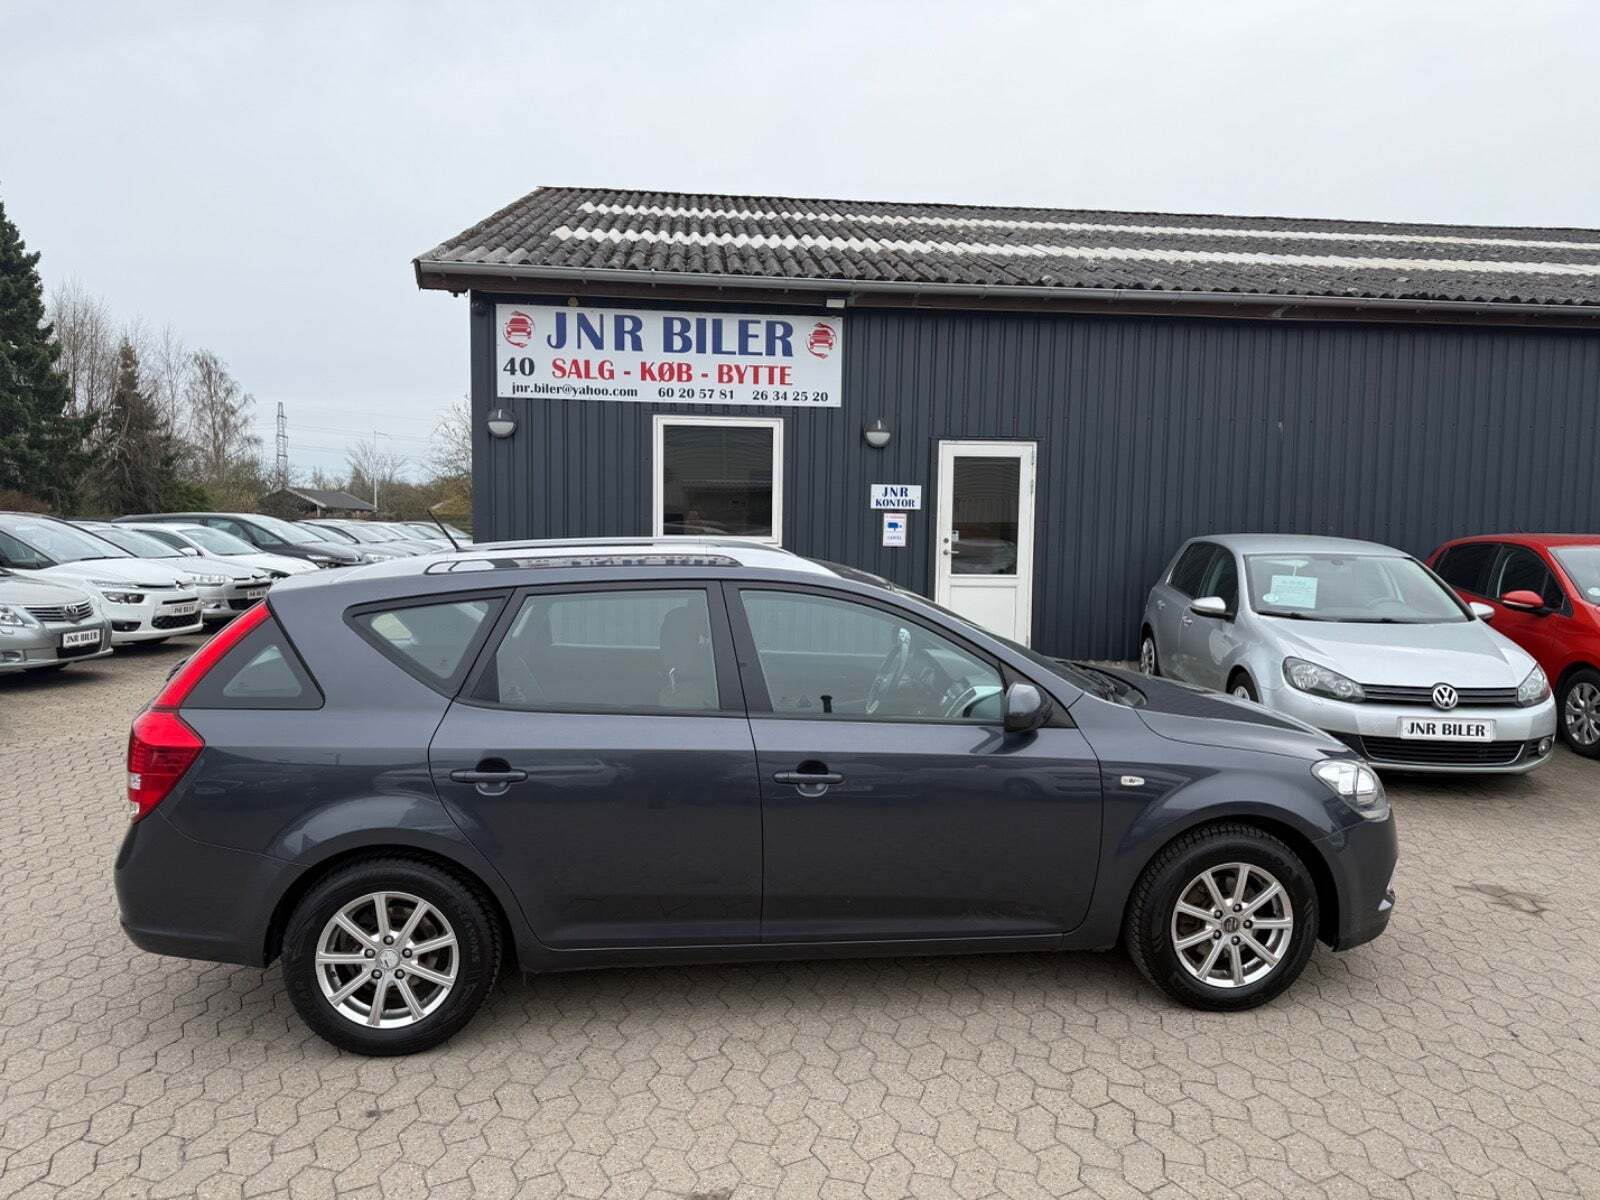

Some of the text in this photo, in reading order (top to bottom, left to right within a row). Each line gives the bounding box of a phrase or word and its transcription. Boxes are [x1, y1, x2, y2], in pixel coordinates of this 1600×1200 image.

[546, 311, 794, 357] JNR BILER
[503, 356, 535, 377] 40
[551, 357, 615, 381] SALG
[640, 361, 693, 383] KØB
[717, 363, 793, 386] BYTTE
[512, 382, 638, 398] jnr.biler@yahoo.com
[658, 387, 735, 400] 60 20 57 81
[752, 390, 829, 402] 26 34 25 20
[882, 486, 909, 498] JNR
[875, 498, 916, 508] KONTOR
[1407, 721, 1486, 737] JNR BILER
